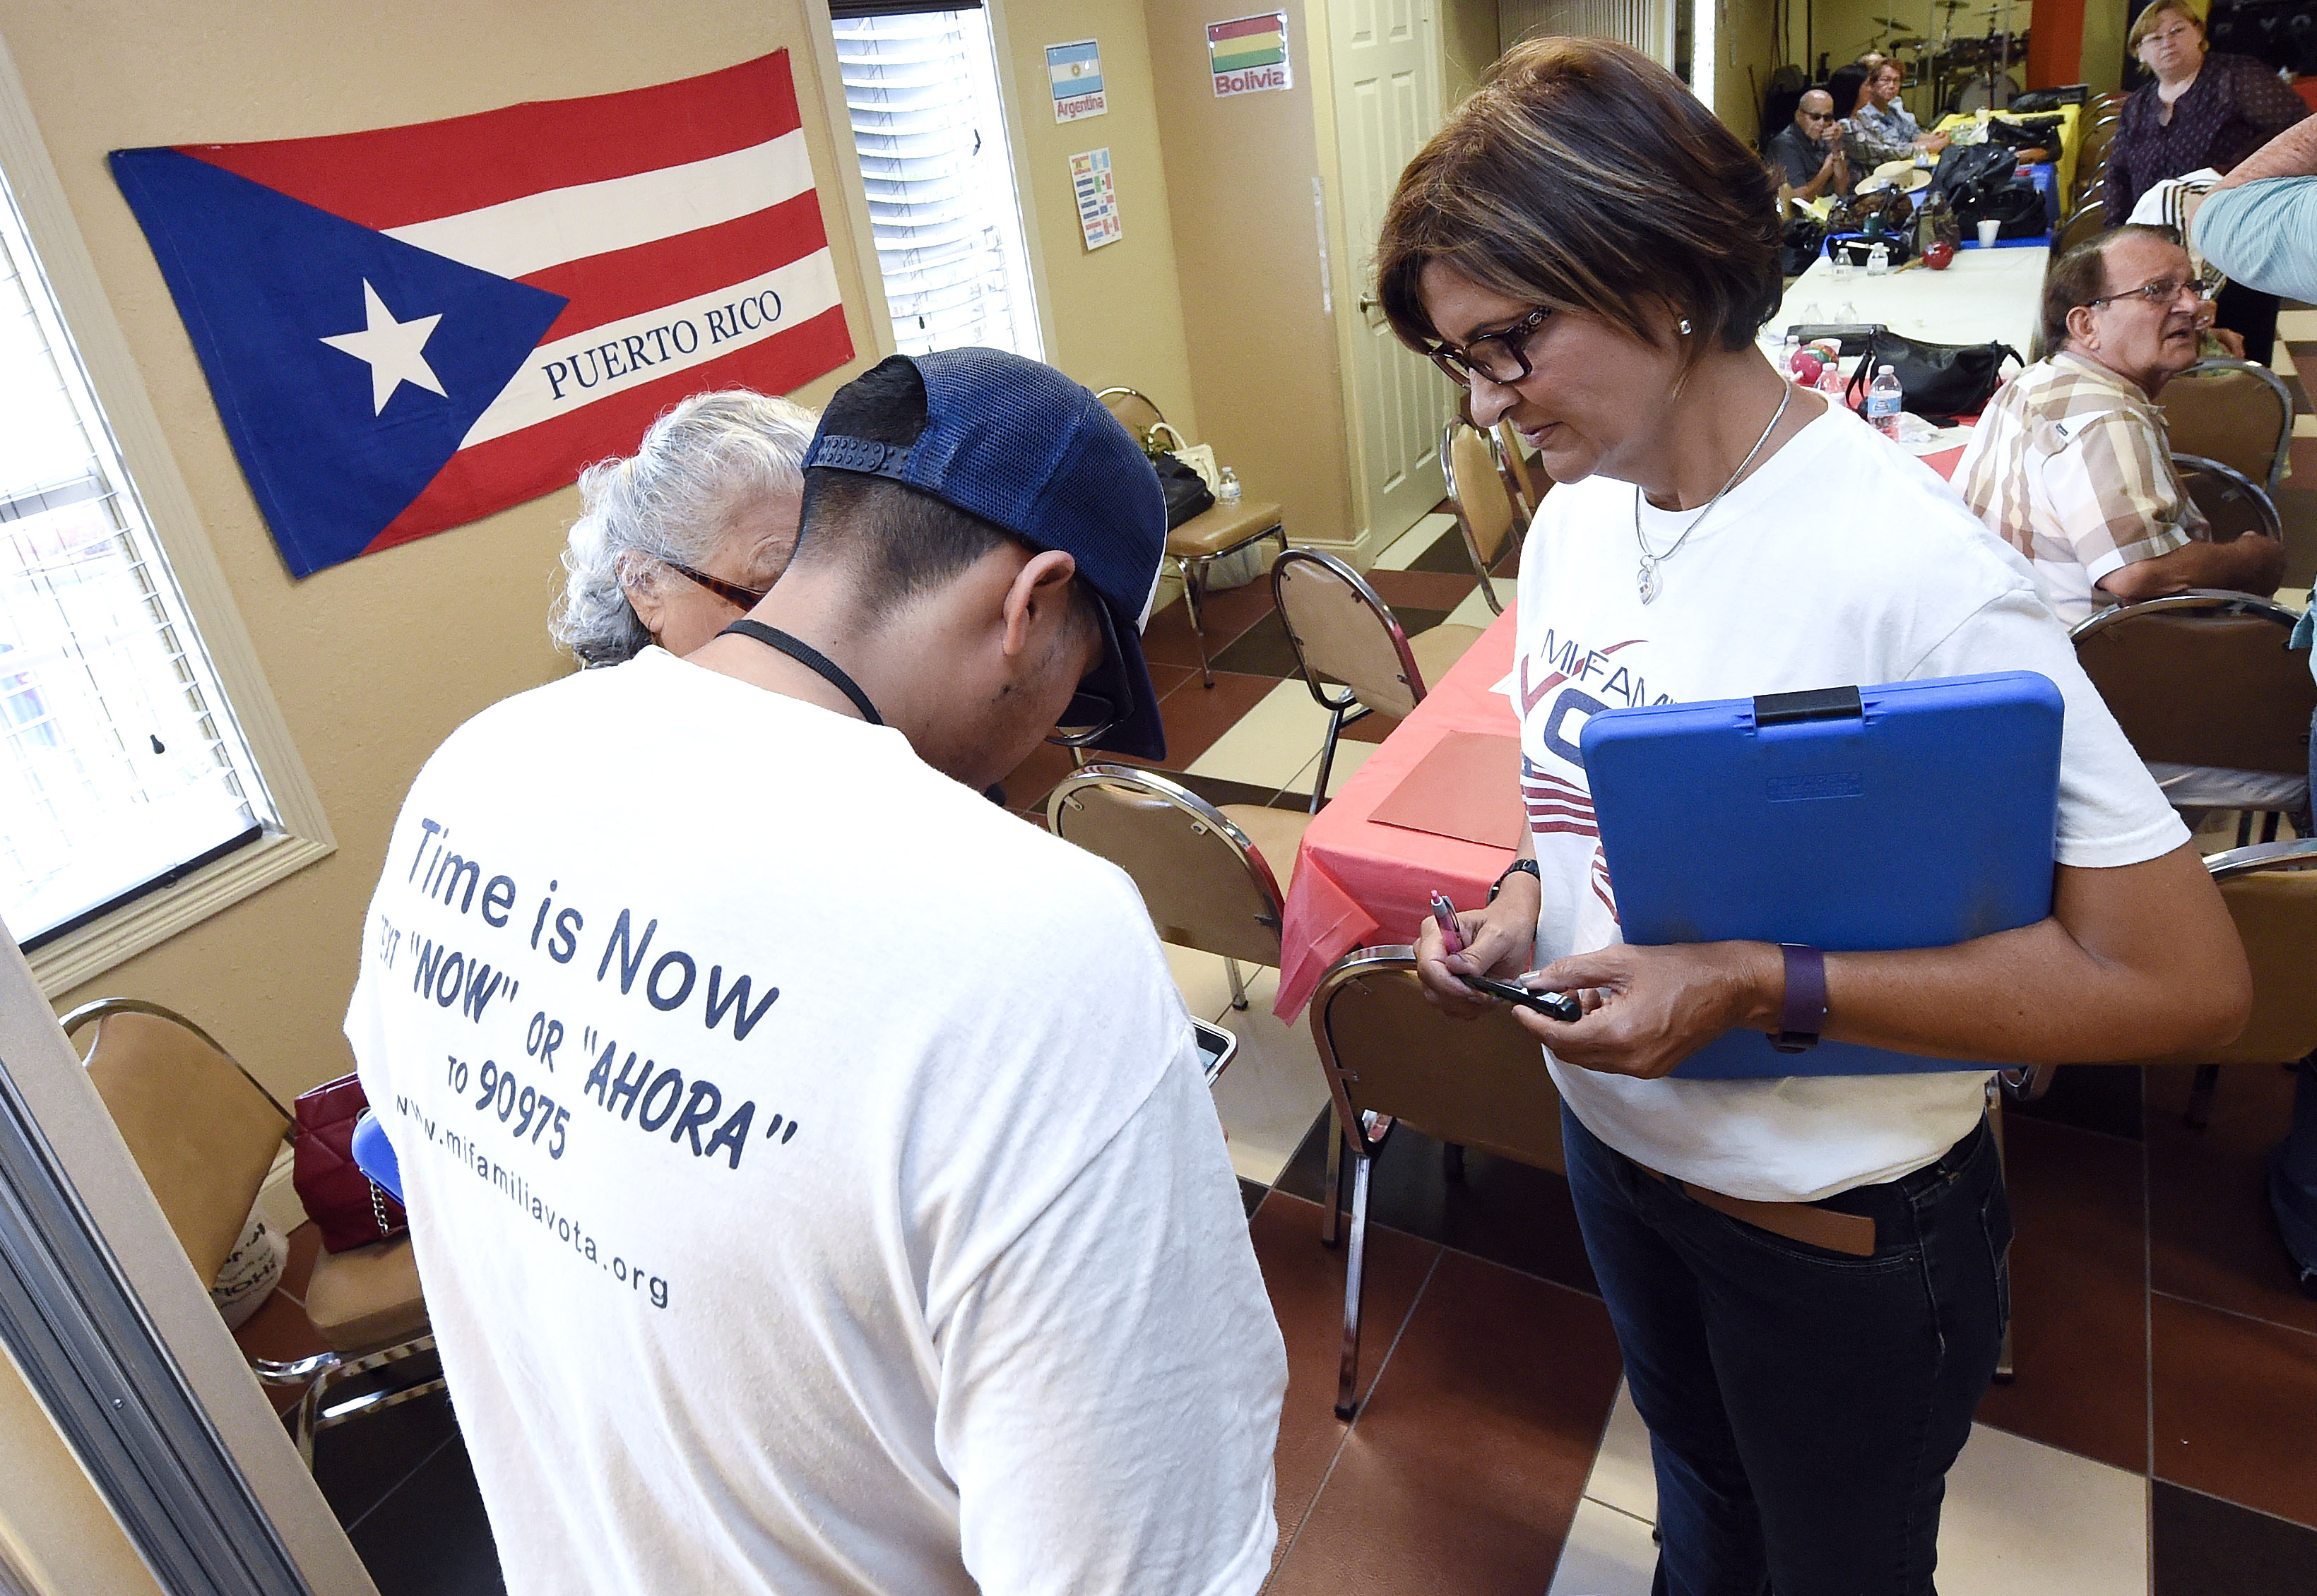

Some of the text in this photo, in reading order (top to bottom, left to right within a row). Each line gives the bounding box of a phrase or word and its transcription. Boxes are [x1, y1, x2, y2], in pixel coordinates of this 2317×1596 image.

[1057, 95, 1104, 118] Argentina
[1215, 69, 1284, 94] Bolivia
[541, 290, 782, 400] PUERTO RICO
[1580, 649, 1678, 708] FAM
[409, 818, 780, 1042] Time is Now
[410, 931, 519, 1025] "NOW"
[526, 1011, 564, 1073] OR
[583, 1025, 798, 1169] "AHORA"
[447, 1055, 571, 1160] TO 90975
